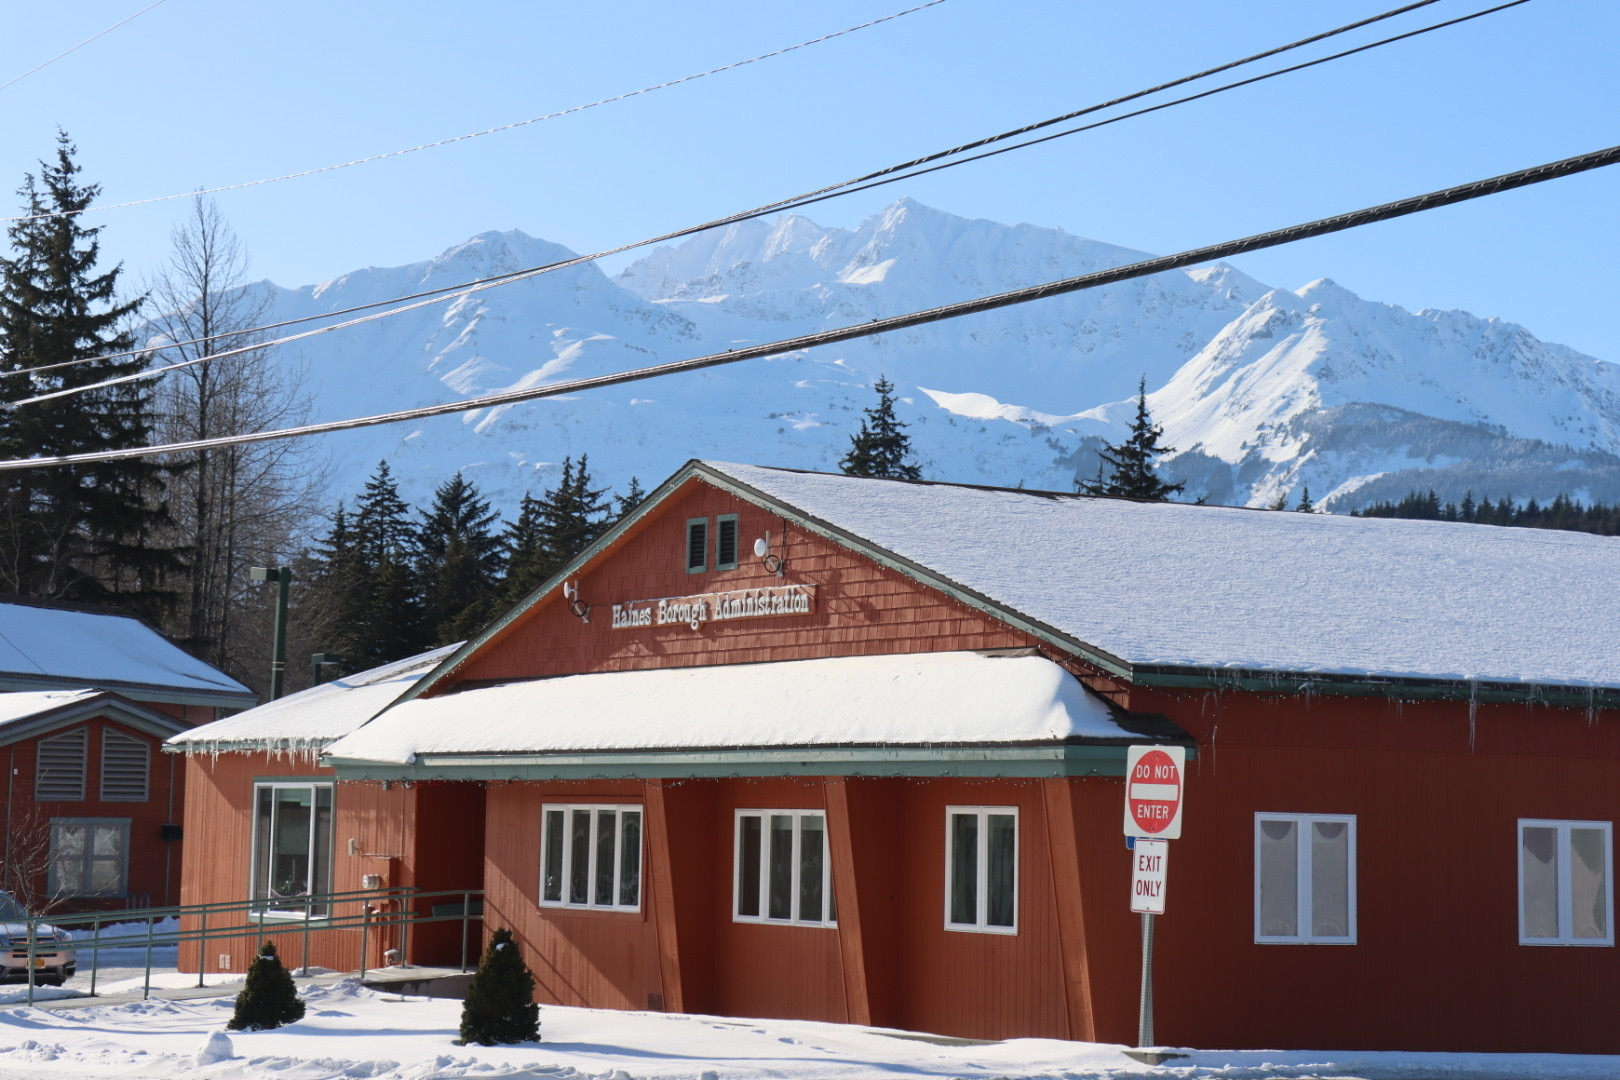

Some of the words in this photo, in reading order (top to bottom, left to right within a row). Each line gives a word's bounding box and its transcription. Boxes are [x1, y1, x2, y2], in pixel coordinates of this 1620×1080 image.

[612, 604, 652, 629] Haines
[657, 599, 707, 631] Borough
[714, 587, 809, 620] Administration
[1136, 764, 1150, 779] DO
[1154, 765, 1176, 779] NOT
[1137, 804, 1169, 819] ENTER
[1138, 855, 1162, 872] EXIT
[1136, 879, 1162, 897] ONLY
